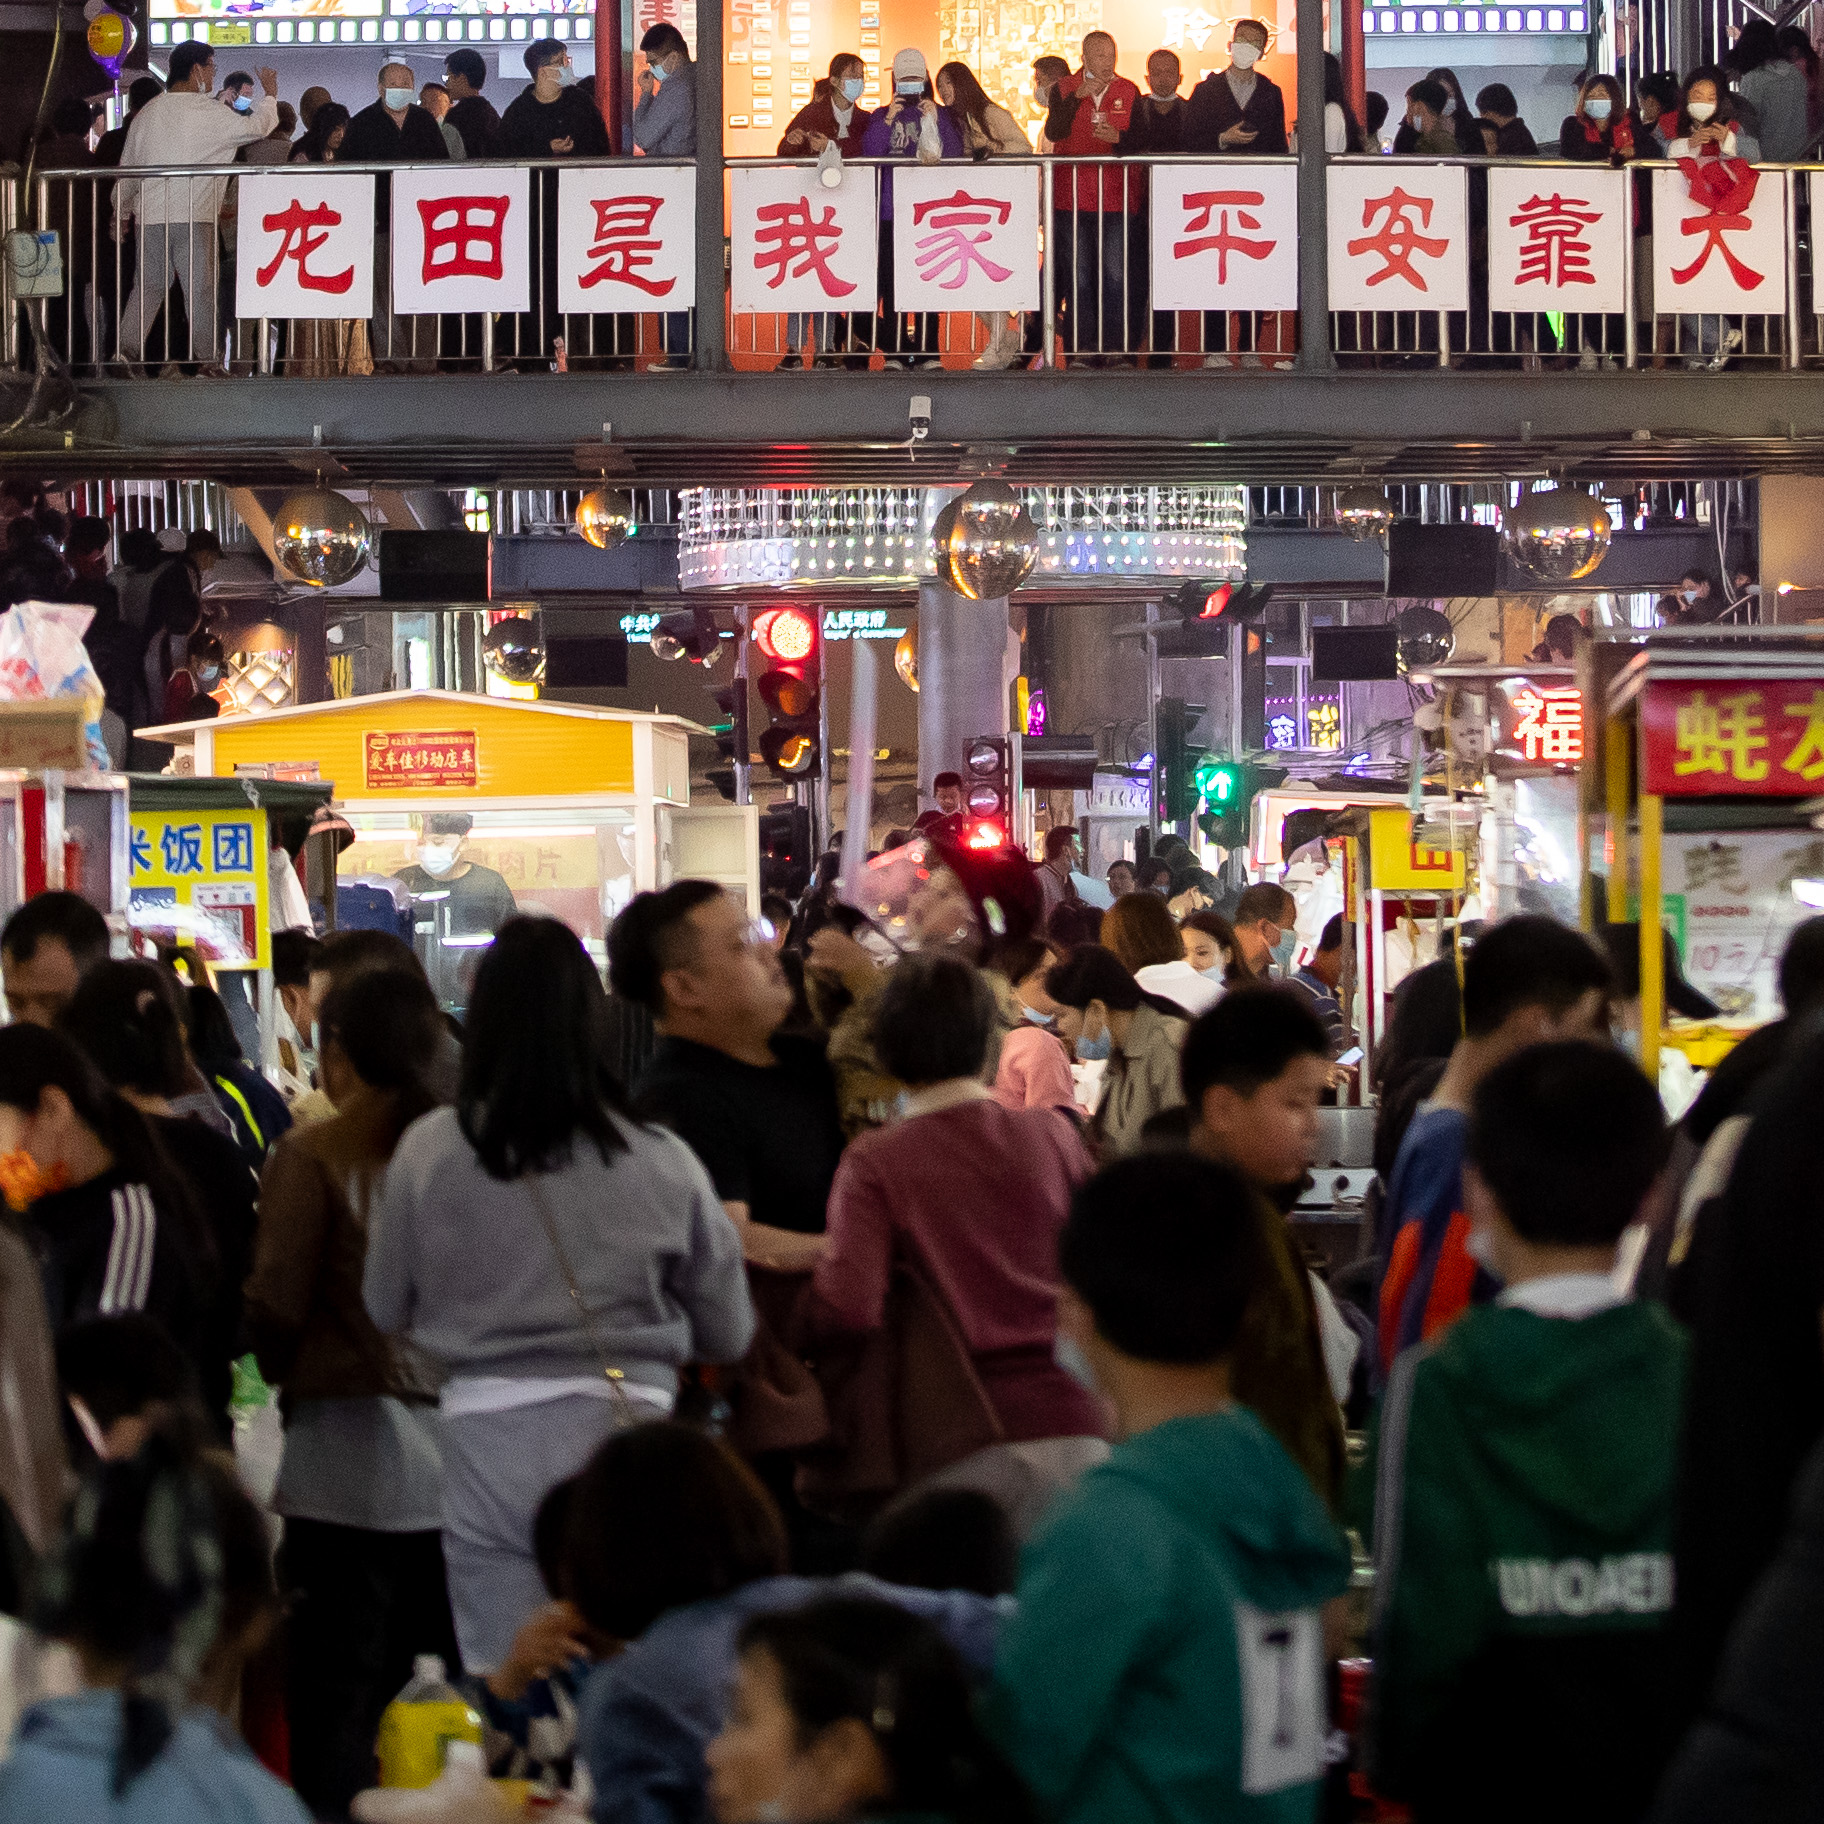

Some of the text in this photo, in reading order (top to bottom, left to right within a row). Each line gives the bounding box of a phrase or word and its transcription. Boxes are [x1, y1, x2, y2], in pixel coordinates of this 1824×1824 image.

[256, 189, 1014, 297] 龙田是我家
[1513, 688, 1583, 761] 福
